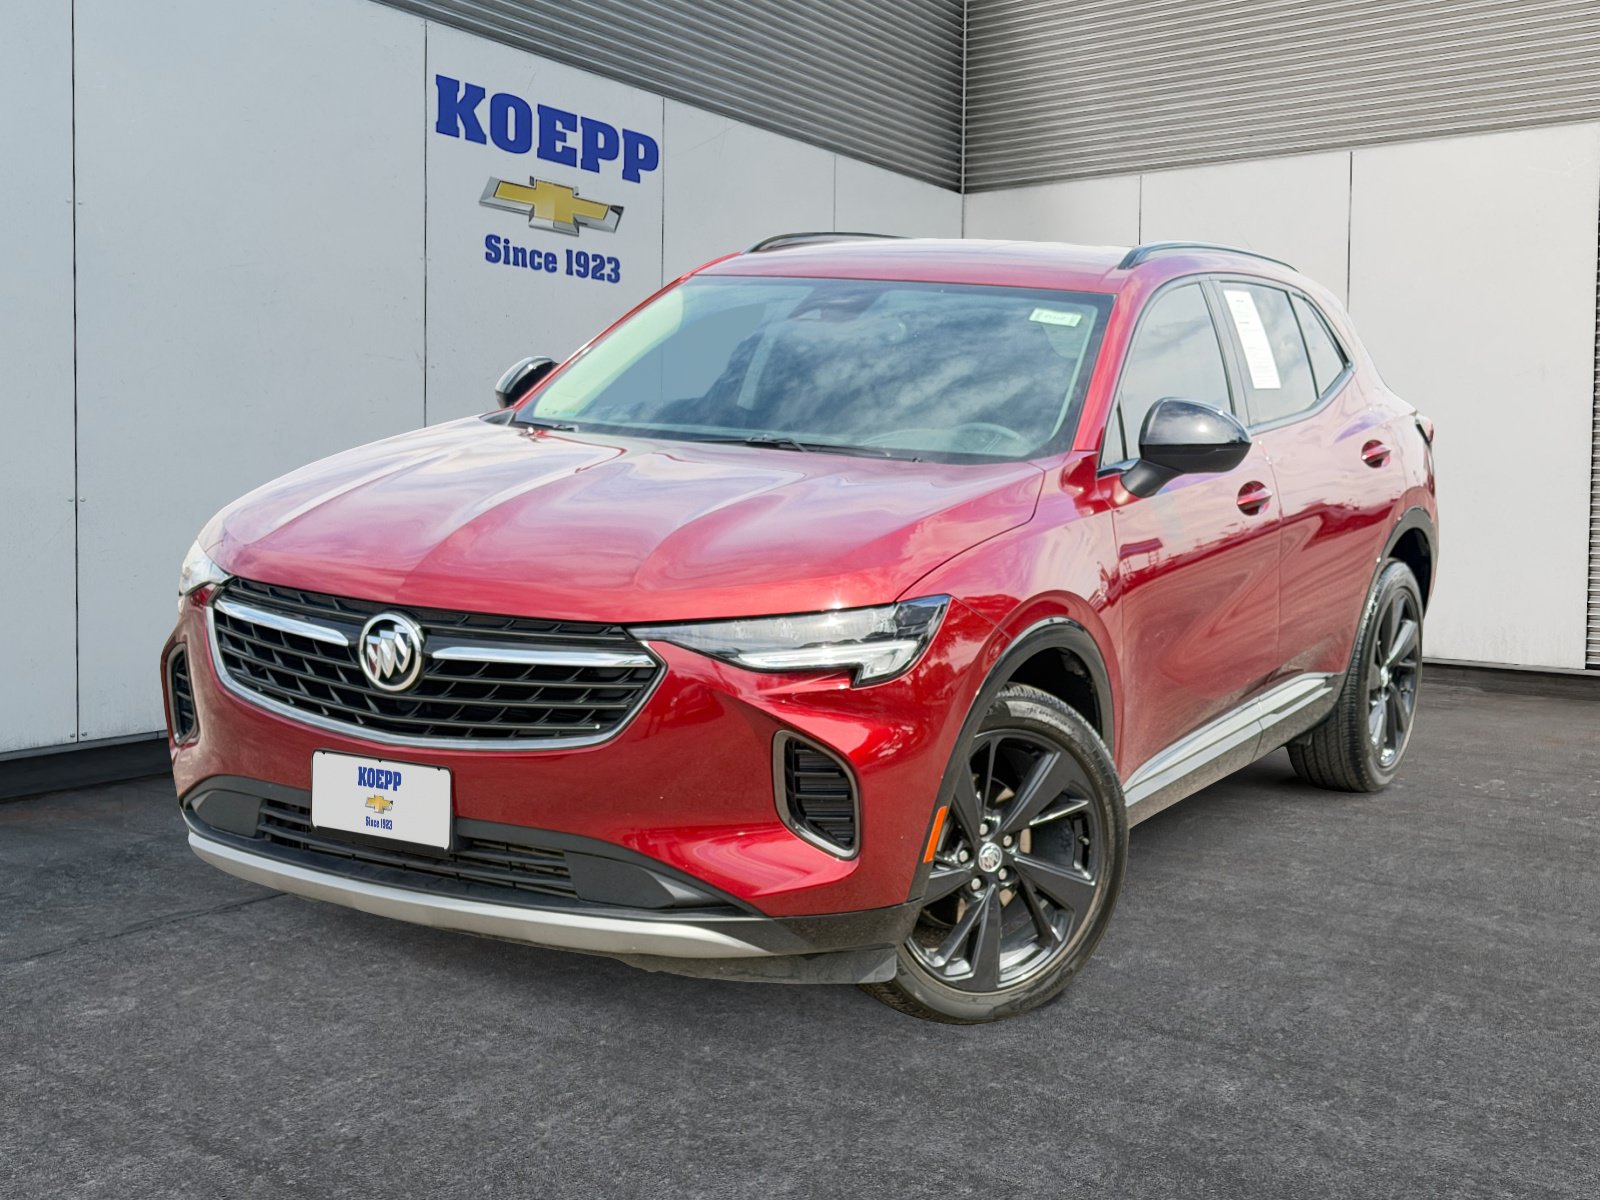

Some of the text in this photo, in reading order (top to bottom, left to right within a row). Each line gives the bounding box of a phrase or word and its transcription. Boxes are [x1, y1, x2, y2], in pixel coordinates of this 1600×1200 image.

[435, 74, 659, 184] KOEPP
[485, 234, 621, 284] Since 1923
[357, 766, 402, 791] KOEPP
[365, 815, 393, 831] Since 1923
